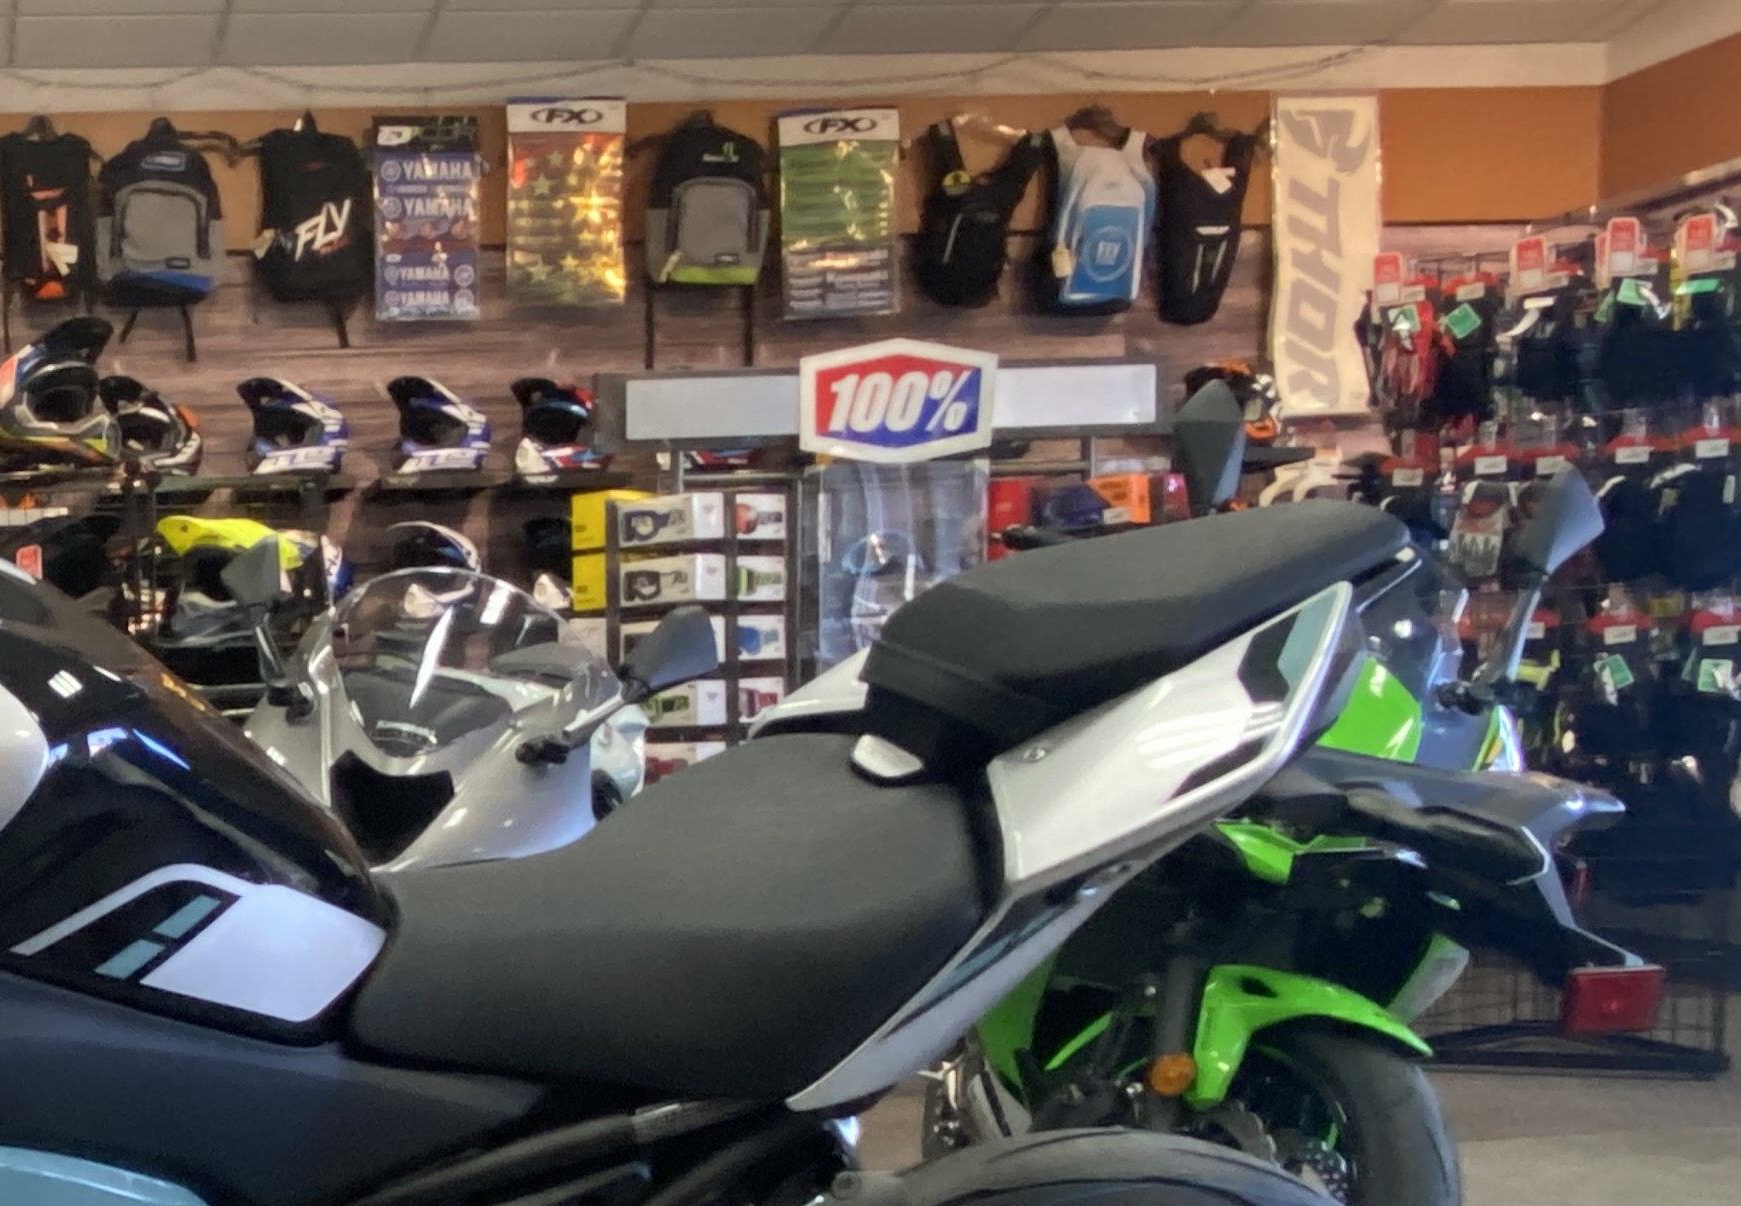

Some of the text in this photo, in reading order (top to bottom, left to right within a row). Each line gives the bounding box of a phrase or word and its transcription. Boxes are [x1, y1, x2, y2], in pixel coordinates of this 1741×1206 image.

[403, 161, 473, 181] YAMAHA
[403, 197, 473, 217] YAMAHA
[294, 198, 352, 263] FLY
[399, 266, 450, 281] YAMAHA
[400, 291, 450, 306] YAMAHA
[1287, 176, 1343, 410] THOR
[828, 370, 974, 433] 100%
